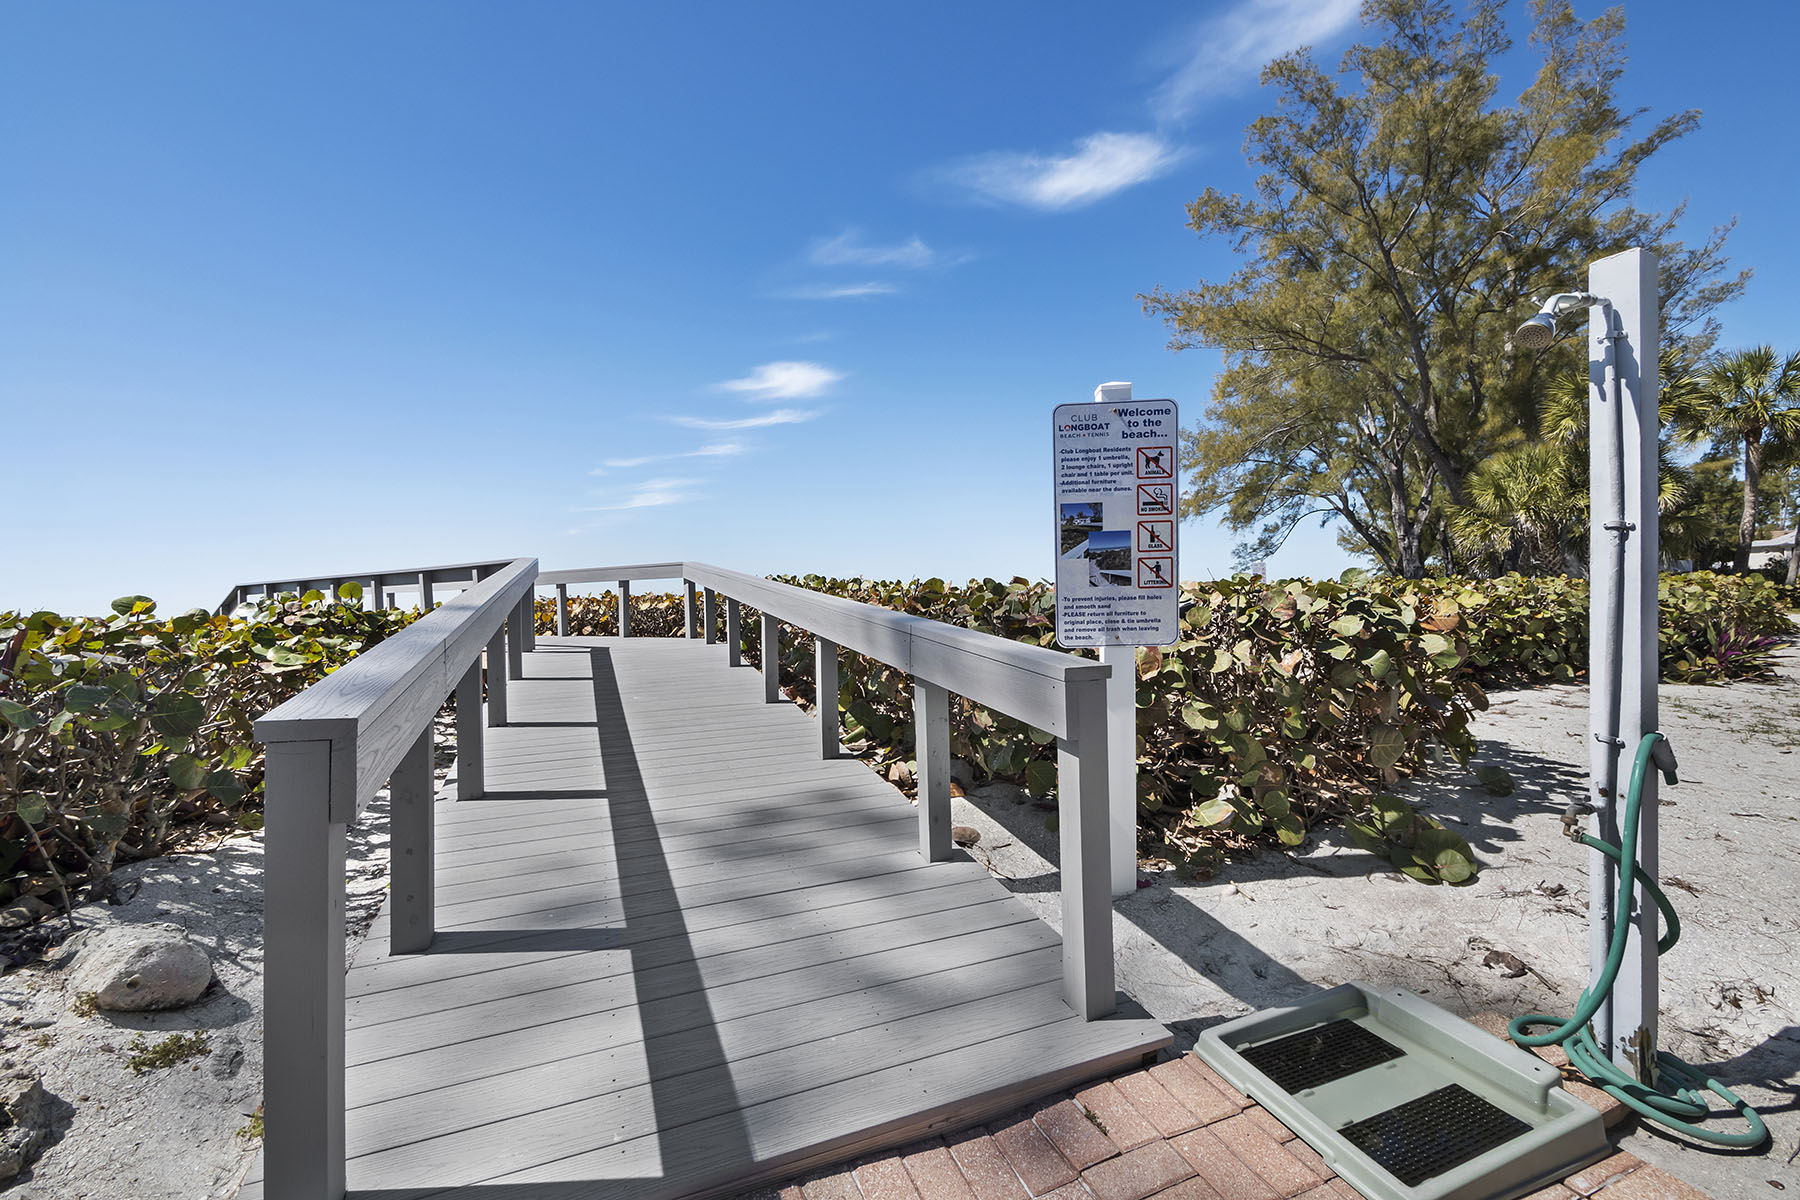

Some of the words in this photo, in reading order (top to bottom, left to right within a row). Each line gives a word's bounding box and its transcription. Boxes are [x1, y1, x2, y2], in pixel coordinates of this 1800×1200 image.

[1118, 408, 1171, 417] Welcome
[1071, 414, 1098, 422] CLUB
[1059, 423, 1110, 431] LONGBOAT
[1122, 430, 1168, 439] beach...
